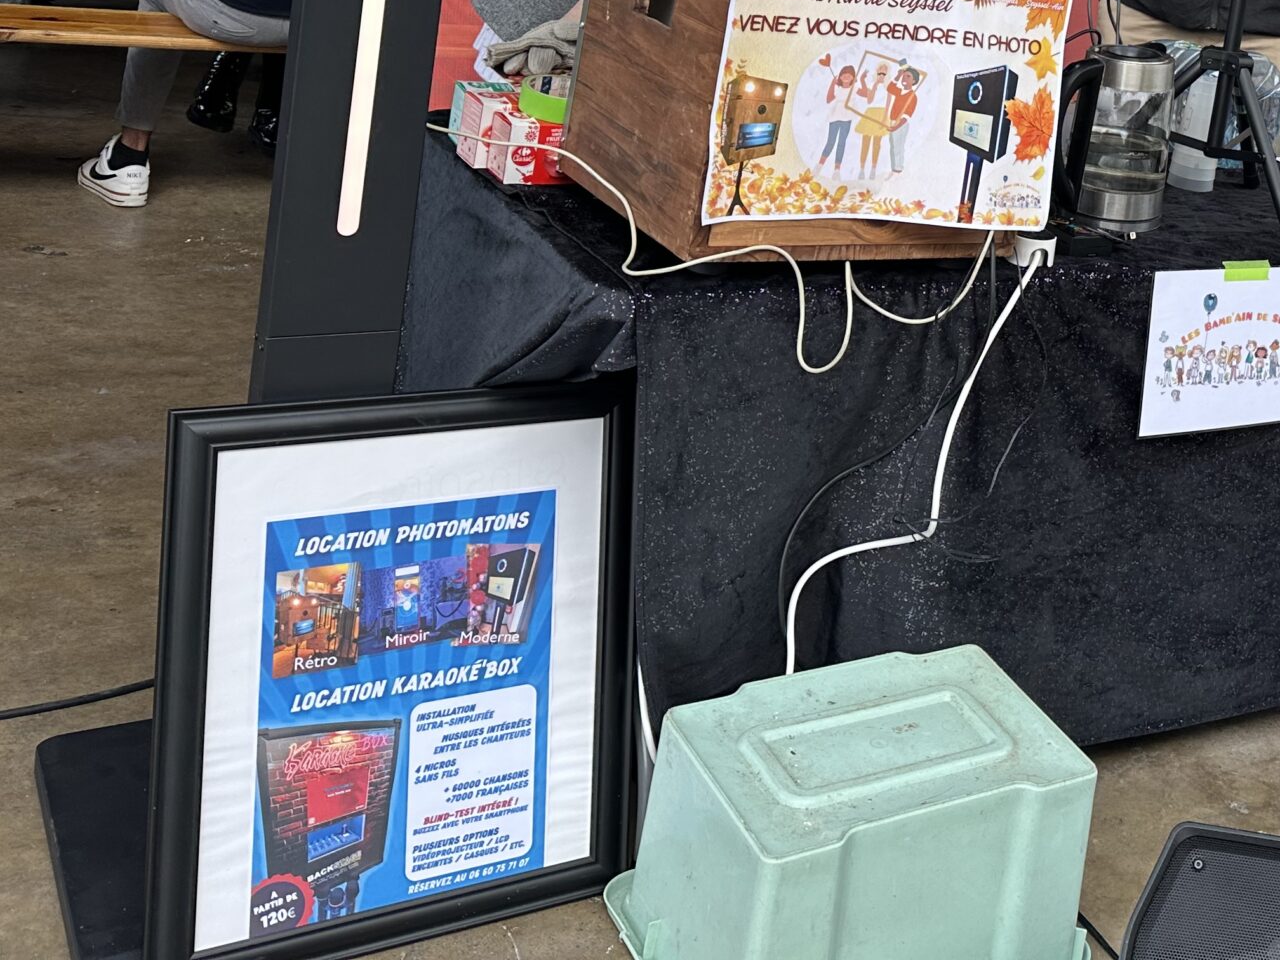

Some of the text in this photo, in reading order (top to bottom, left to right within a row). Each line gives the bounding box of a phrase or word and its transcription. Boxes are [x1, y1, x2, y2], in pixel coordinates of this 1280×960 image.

[739, 14, 1042, 56] VENEZ VOUS PRENDRE EN PHOTO
[1180, 328, 1201, 345] LES
[1204, 311, 1253, 332] BAMB'AIN
[1256, 313, 1268, 321] DE
[294, 511, 530, 557] LOCATION PHOTOMATONS
[385, 629, 520, 648] Miroir Moderne
[294, 655, 338, 671] Rétro
[290, 680, 386, 713] LOCATION
[416, 704, 477, 722] INSTALLATION
[416, 709, 495, 732] ULTRA-SIMPLIFIÉE
[433, 728, 532, 755] ENTRE LES CHANTEURS
[441, 717, 532, 743] MUSIQUES INTÉGRÉES
[414, 768, 459, 785] SANS FILS
[415, 758, 456, 774] 4 MICROS
[452, 779, 481, 792] 60000
[483, 769, 529, 786] CHANSONS
[475, 779, 529, 798] FRANÇAISES
[423, 806, 476, 825] BLIND-TEST
[476, 796, 514, 814] INTÉGRÉ
[441, 820, 459, 830] AVEC
[461, 814, 482, 825] VOTRE
[484, 804, 528, 820] SMARTPHONE
[412, 827, 500, 854] PLUSIEURS OPTIONS
[412, 841, 485, 863] VIDÉOPROJECTEUR
[494, 834, 510, 844] LCD
[411, 855, 453, 872] ENCEINTES
[463, 845, 499, 860] CASQUES
[407, 857, 530, 894] RÉSERVEZ AU 06 60 75 71 07
[253, 892, 298, 916] PARTIR DE
[270, 891, 278, 899] A
[260, 906, 296, 928] 120€
